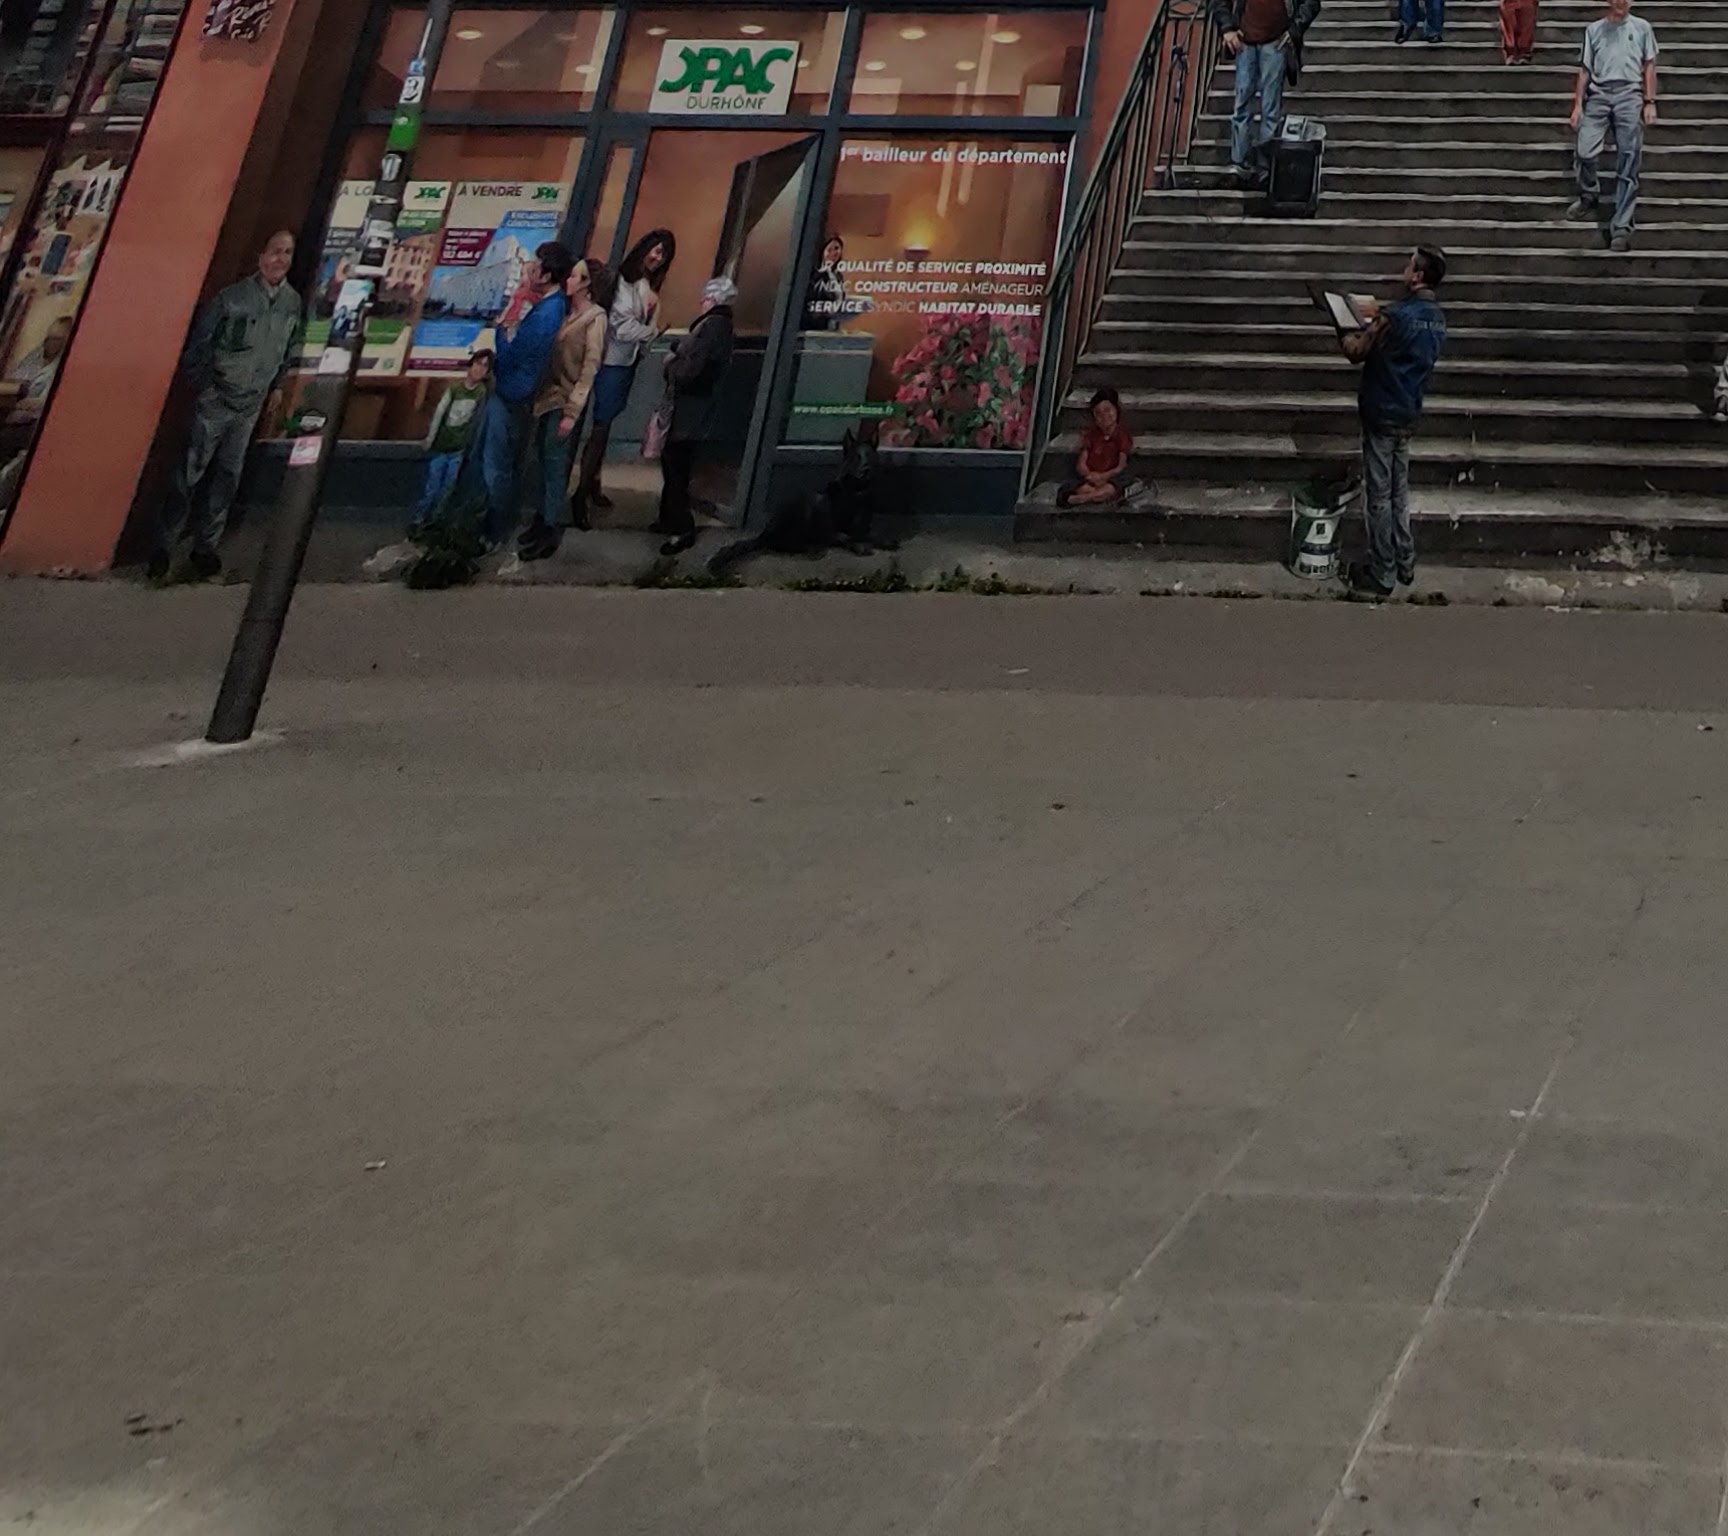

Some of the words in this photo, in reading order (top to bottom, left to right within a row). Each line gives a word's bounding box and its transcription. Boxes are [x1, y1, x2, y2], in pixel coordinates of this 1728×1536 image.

[862, 147, 927, 163] bailleur
[930, 147, 953, 163] du
[957, 147, 1067, 166] département
[472, 185, 523, 197] VENDRE
[836, 259, 894, 273] QUALITÉ
[896, 261, 915, 274] DE
[917, 261, 972, 274] SERVICE
[975, 261, 1047, 276] PROXIMITÉ
[854, 280, 958, 294] CONSTRUCTEUR
[960, 280, 1044, 296] AMÉNAGEUR
[918, 301, 976, 315] HABITAT
[977, 302, 1042, 317] DURABLE
